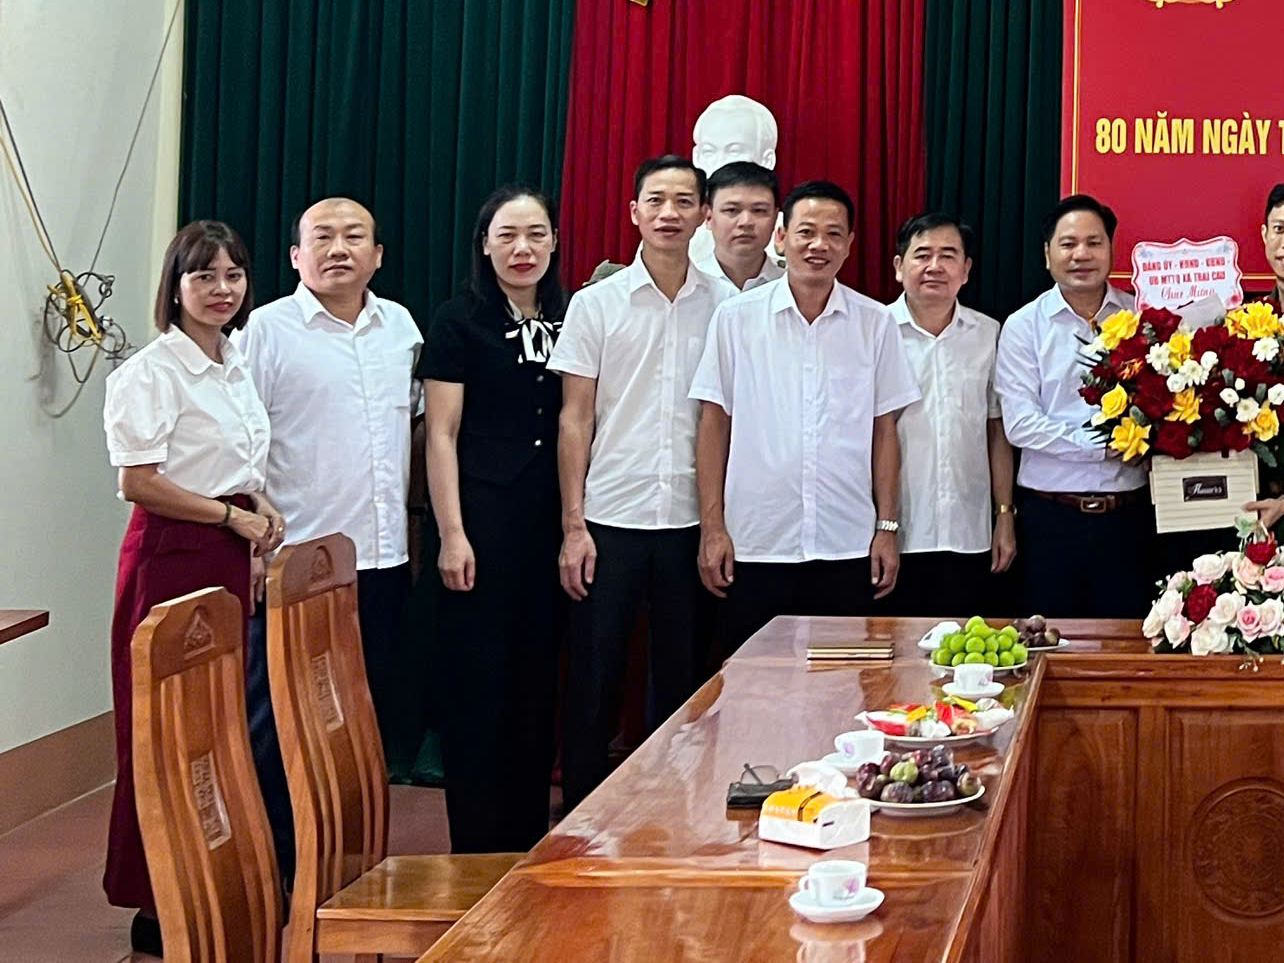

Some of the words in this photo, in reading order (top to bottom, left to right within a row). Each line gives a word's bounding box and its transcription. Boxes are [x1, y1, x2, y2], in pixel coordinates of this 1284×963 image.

[1095, 117, 1127, 154] 80
[1134, 111, 1194, 155] NĂM
[1202, 111, 1271, 155] NGÀY
